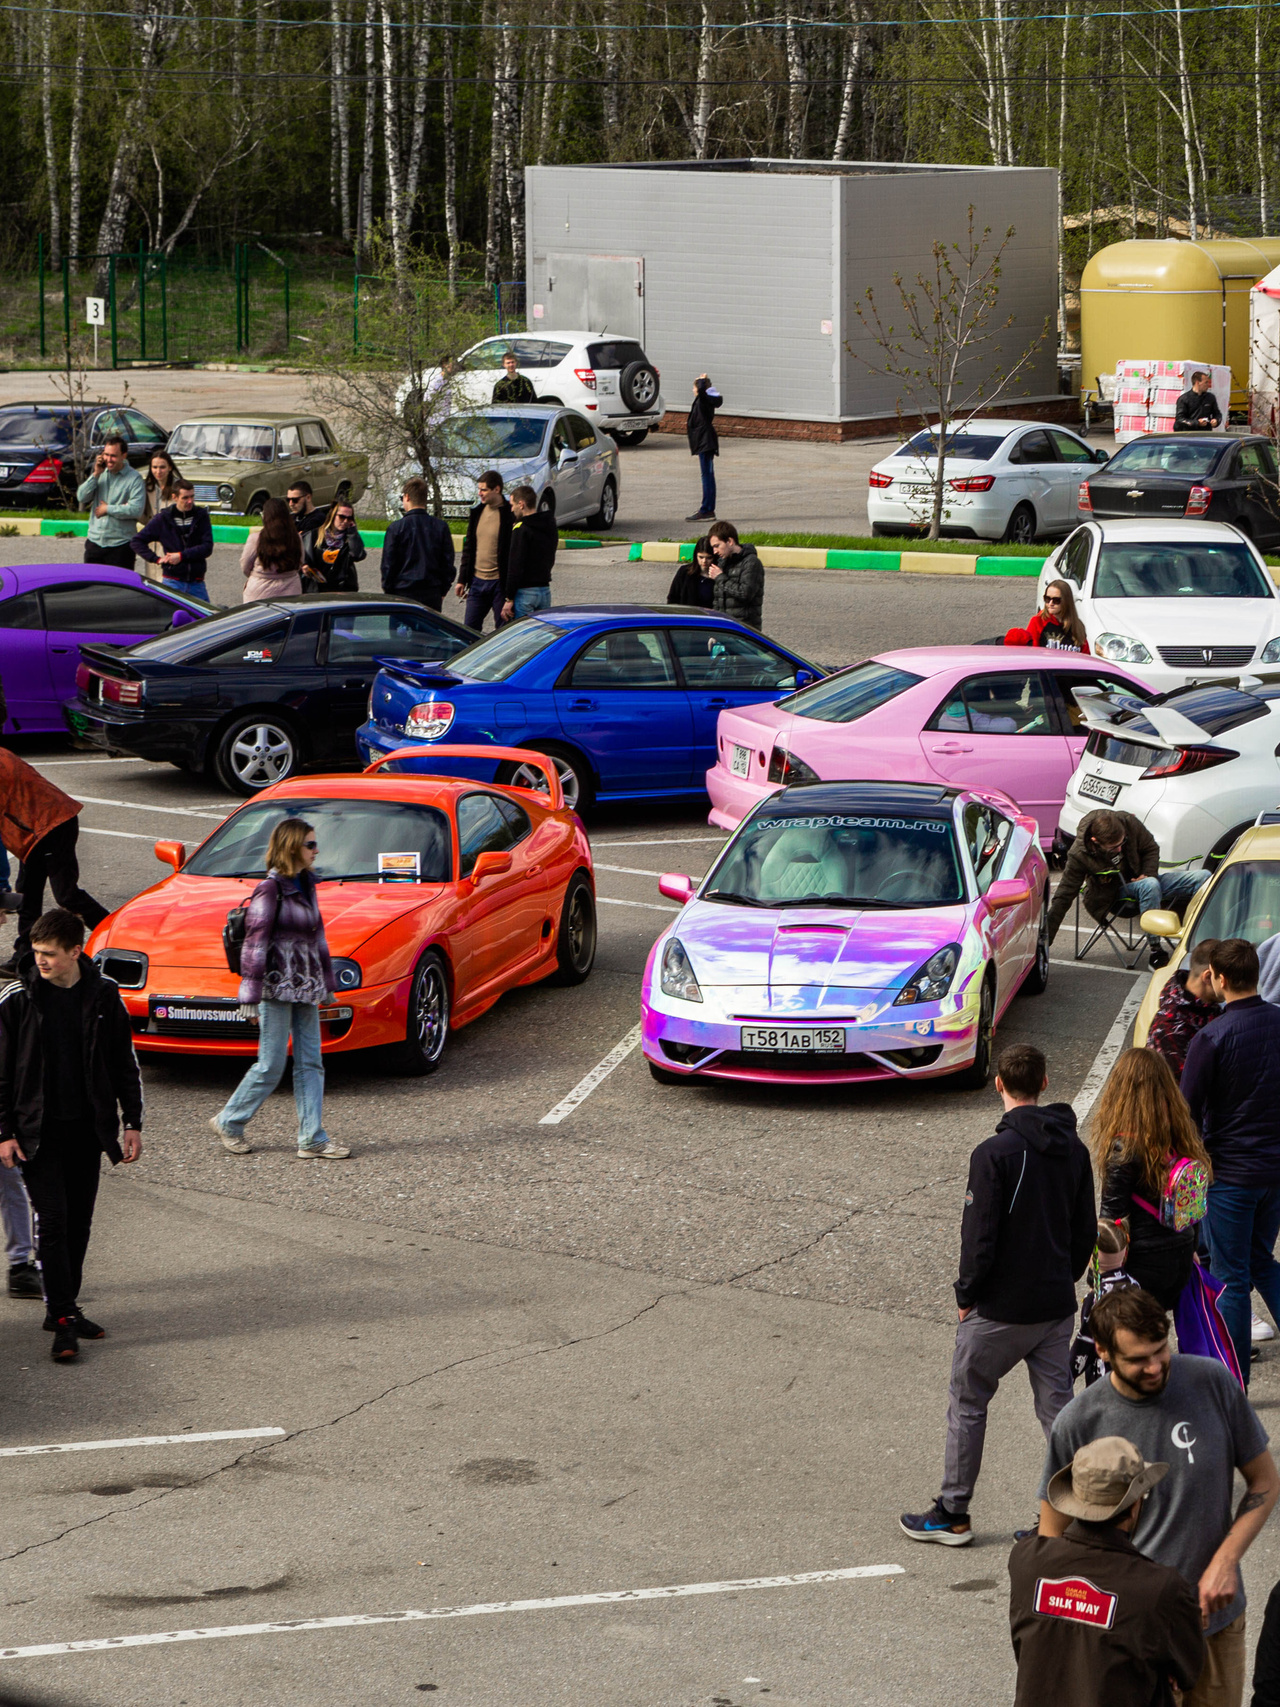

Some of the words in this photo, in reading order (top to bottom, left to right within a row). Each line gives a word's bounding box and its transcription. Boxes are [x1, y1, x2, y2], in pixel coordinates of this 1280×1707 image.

[93, 302, 99, 318] 3
[757, 816, 946, 834] wrapteam.ru
[747, 1030, 811, 1048] Т581АВ
[815, 1030, 840, 1044] 152
[1048, 1595, 1073, 1610] SILK
[1076, 1601, 1100, 1615] WAY
